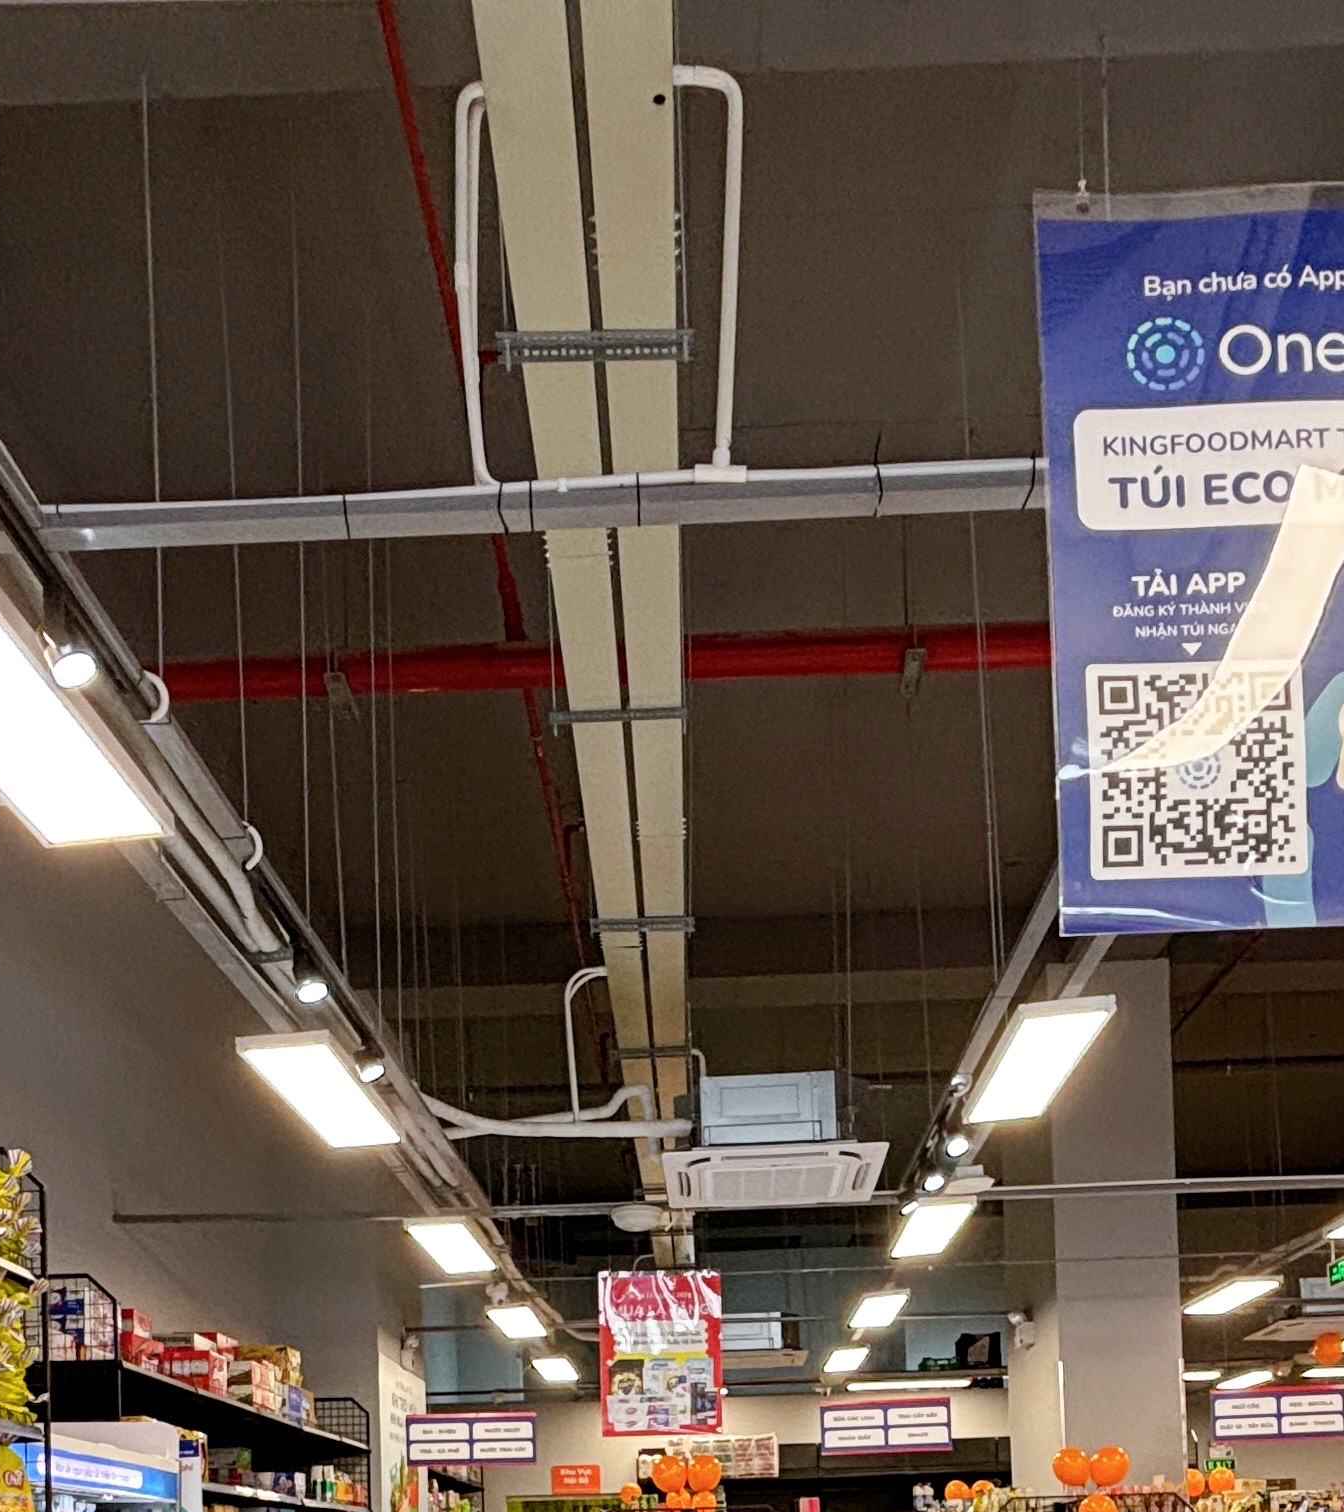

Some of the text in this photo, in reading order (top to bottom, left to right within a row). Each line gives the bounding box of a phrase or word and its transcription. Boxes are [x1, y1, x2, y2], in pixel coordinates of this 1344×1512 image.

[1143, 274, 1192, 301] Bạn
[1198, 271, 1258, 295] chưa
[1263, 266, 1293, 290] có
[1102, 427, 1331, 457] KINGFOODMART
[1107, 466, 1186, 509] TÚI
[1203, 471, 1295, 507] ECO
[1131, 568, 1246, 597] TẢI APP
[1112, 602, 1155, 618] ĐĂNG
[1158, 601, 1178, 617] KÝ
[1207, 1460, 1233, 1470] EXIT
